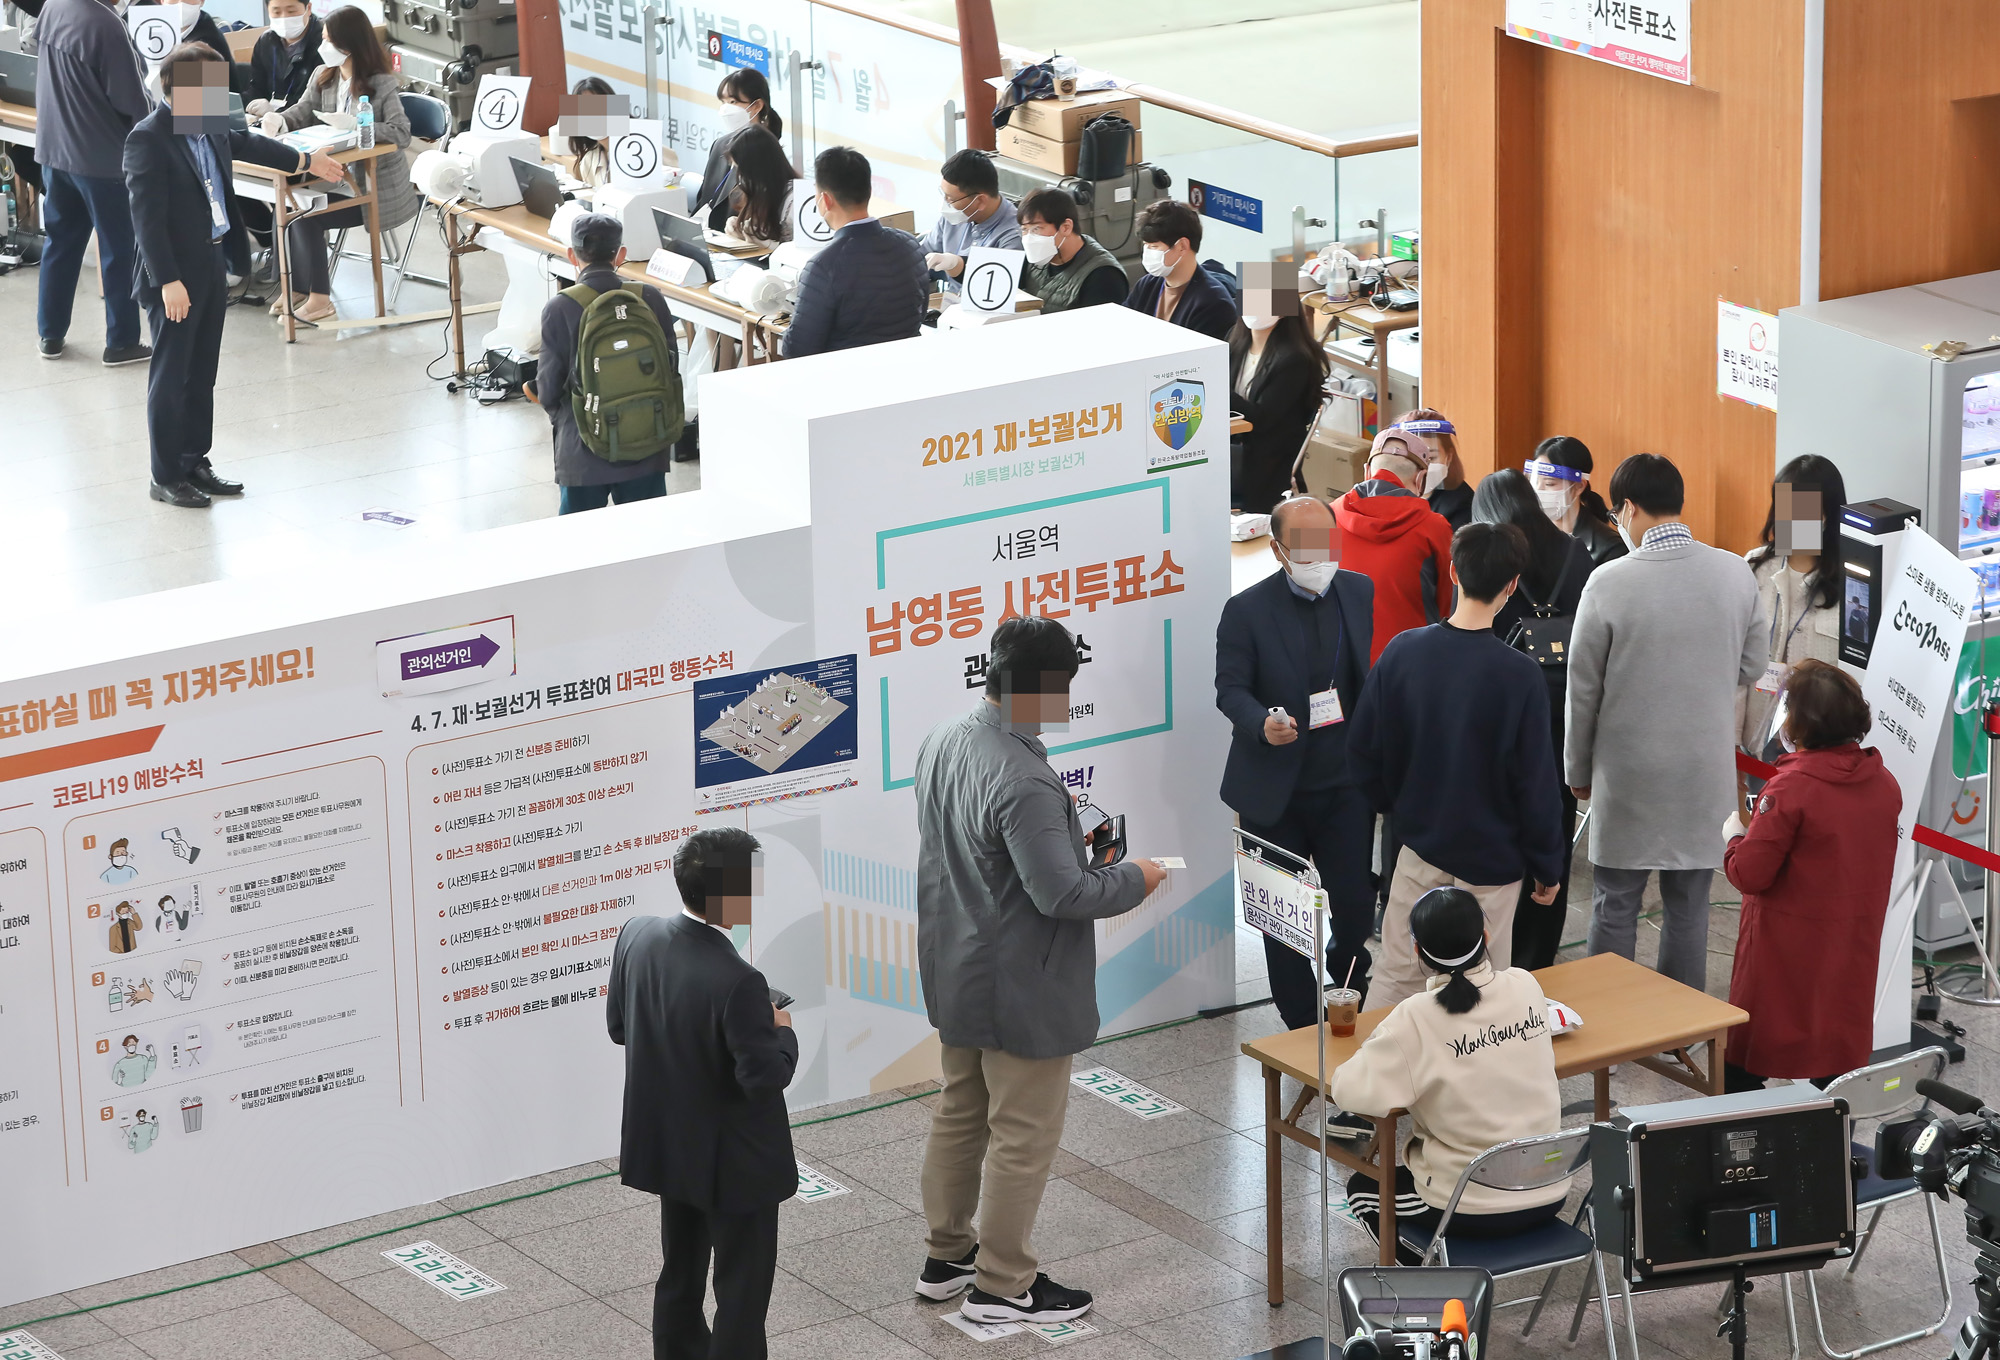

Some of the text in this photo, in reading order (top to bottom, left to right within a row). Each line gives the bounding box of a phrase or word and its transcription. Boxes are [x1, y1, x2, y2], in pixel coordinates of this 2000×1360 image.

[1594, 0, 1676, 41] 사전투표소
[1212, 191, 1257, 215] 기대지 마시오
[1154, 405, 1203, 427] 안심방역
[1160, 393, 1195, 408] 코로나19
[921, 428, 984, 467] 2021
[962, 450, 1086, 488] 서울특별시장 보궐선거
[992, 524, 1059, 561] 서울역
[866, 550, 1184, 656] 남영동 사전투표소
[1905, 563, 1965, 620] 스마트 생활 방역시스템
[1893, 599, 1951, 662] EccoPass
[407, 647, 472, 674] 관외선거인
[89, 685, 116, 720] 때
[126, 678, 153, 710] 꼭
[163, 647, 314, 706] 지켜주세요!
[411, 715, 426, 732] 4.
[432, 711, 447, 729] 7.
[546, 675, 611, 706] 투표참여
[617, 664, 664, 692] 대국민
[670, 650, 734, 681] 행동수칙
[1887, 676, 1906, 702] 비대면
[1878, 709, 1896, 734] 마스크
[1896, 721, 1908, 745] 착용
[442, 734, 589, 775] (사전)투표소 가기 전 신분증 준비하기
[53, 758, 203, 808] 코로나19 예방수칙
[444, 751, 648, 803] 어린 자녀 등은 가급적 (사전)투표소에 동반하지 않기
[445, 782, 634, 832] (사전)투표소 가기 전 꼼꼼하게 30초 이상 손씻기
[88, 838, 92, 847] 1
[447, 821, 582, 860] 마스크 착용하고 (사전)투표소 가기
[448, 829, 678, 889] (사전)투표소 입구에서 발열체크를 받고 손 소독 후 비닐장갑
[449, 897, 499, 917] (사전)투표소
[542, 883, 559, 896] 다른
[562, 875, 597, 892] 선거인과
[600, 874, 613, 883] 1m
[615, 867, 632, 880] 이상
[635, 863, 652, 876] 거리
[654, 859, 671, 872] 두기
[1243, 880, 1313, 933] 관외선거인
[3, 914, 30, 930] 대하여
[90, 907, 97, 916] 2
[451, 925, 500, 946] (사전)투표소
[543, 907, 578, 925] 불필요한
[581, 903, 598, 916] 대화
[600, 895, 634, 911] 자제하기
[1247, 907, 1313, 953] 용산구 관외 주민등록자
[452, 927, 617, 974] (사전)투표소에서 본인 확인 시 마스크 잠깐
[95, 975, 102, 984] 3
[453, 957, 610, 1002] 발열증상 등이 있는 경우 임시기표소에서
[455, 987, 596, 1029] 투표 후 귀가하여 흐르는 물에 비누로
[99, 1042, 106, 1052] 4
[103, 1109, 110, 1119] 5
[1076, 1073, 1168, 1115] 거리두기
[5, 1114, 40, 1131] 있는 경우,
[395, 1248, 485, 1296] 거리두기
